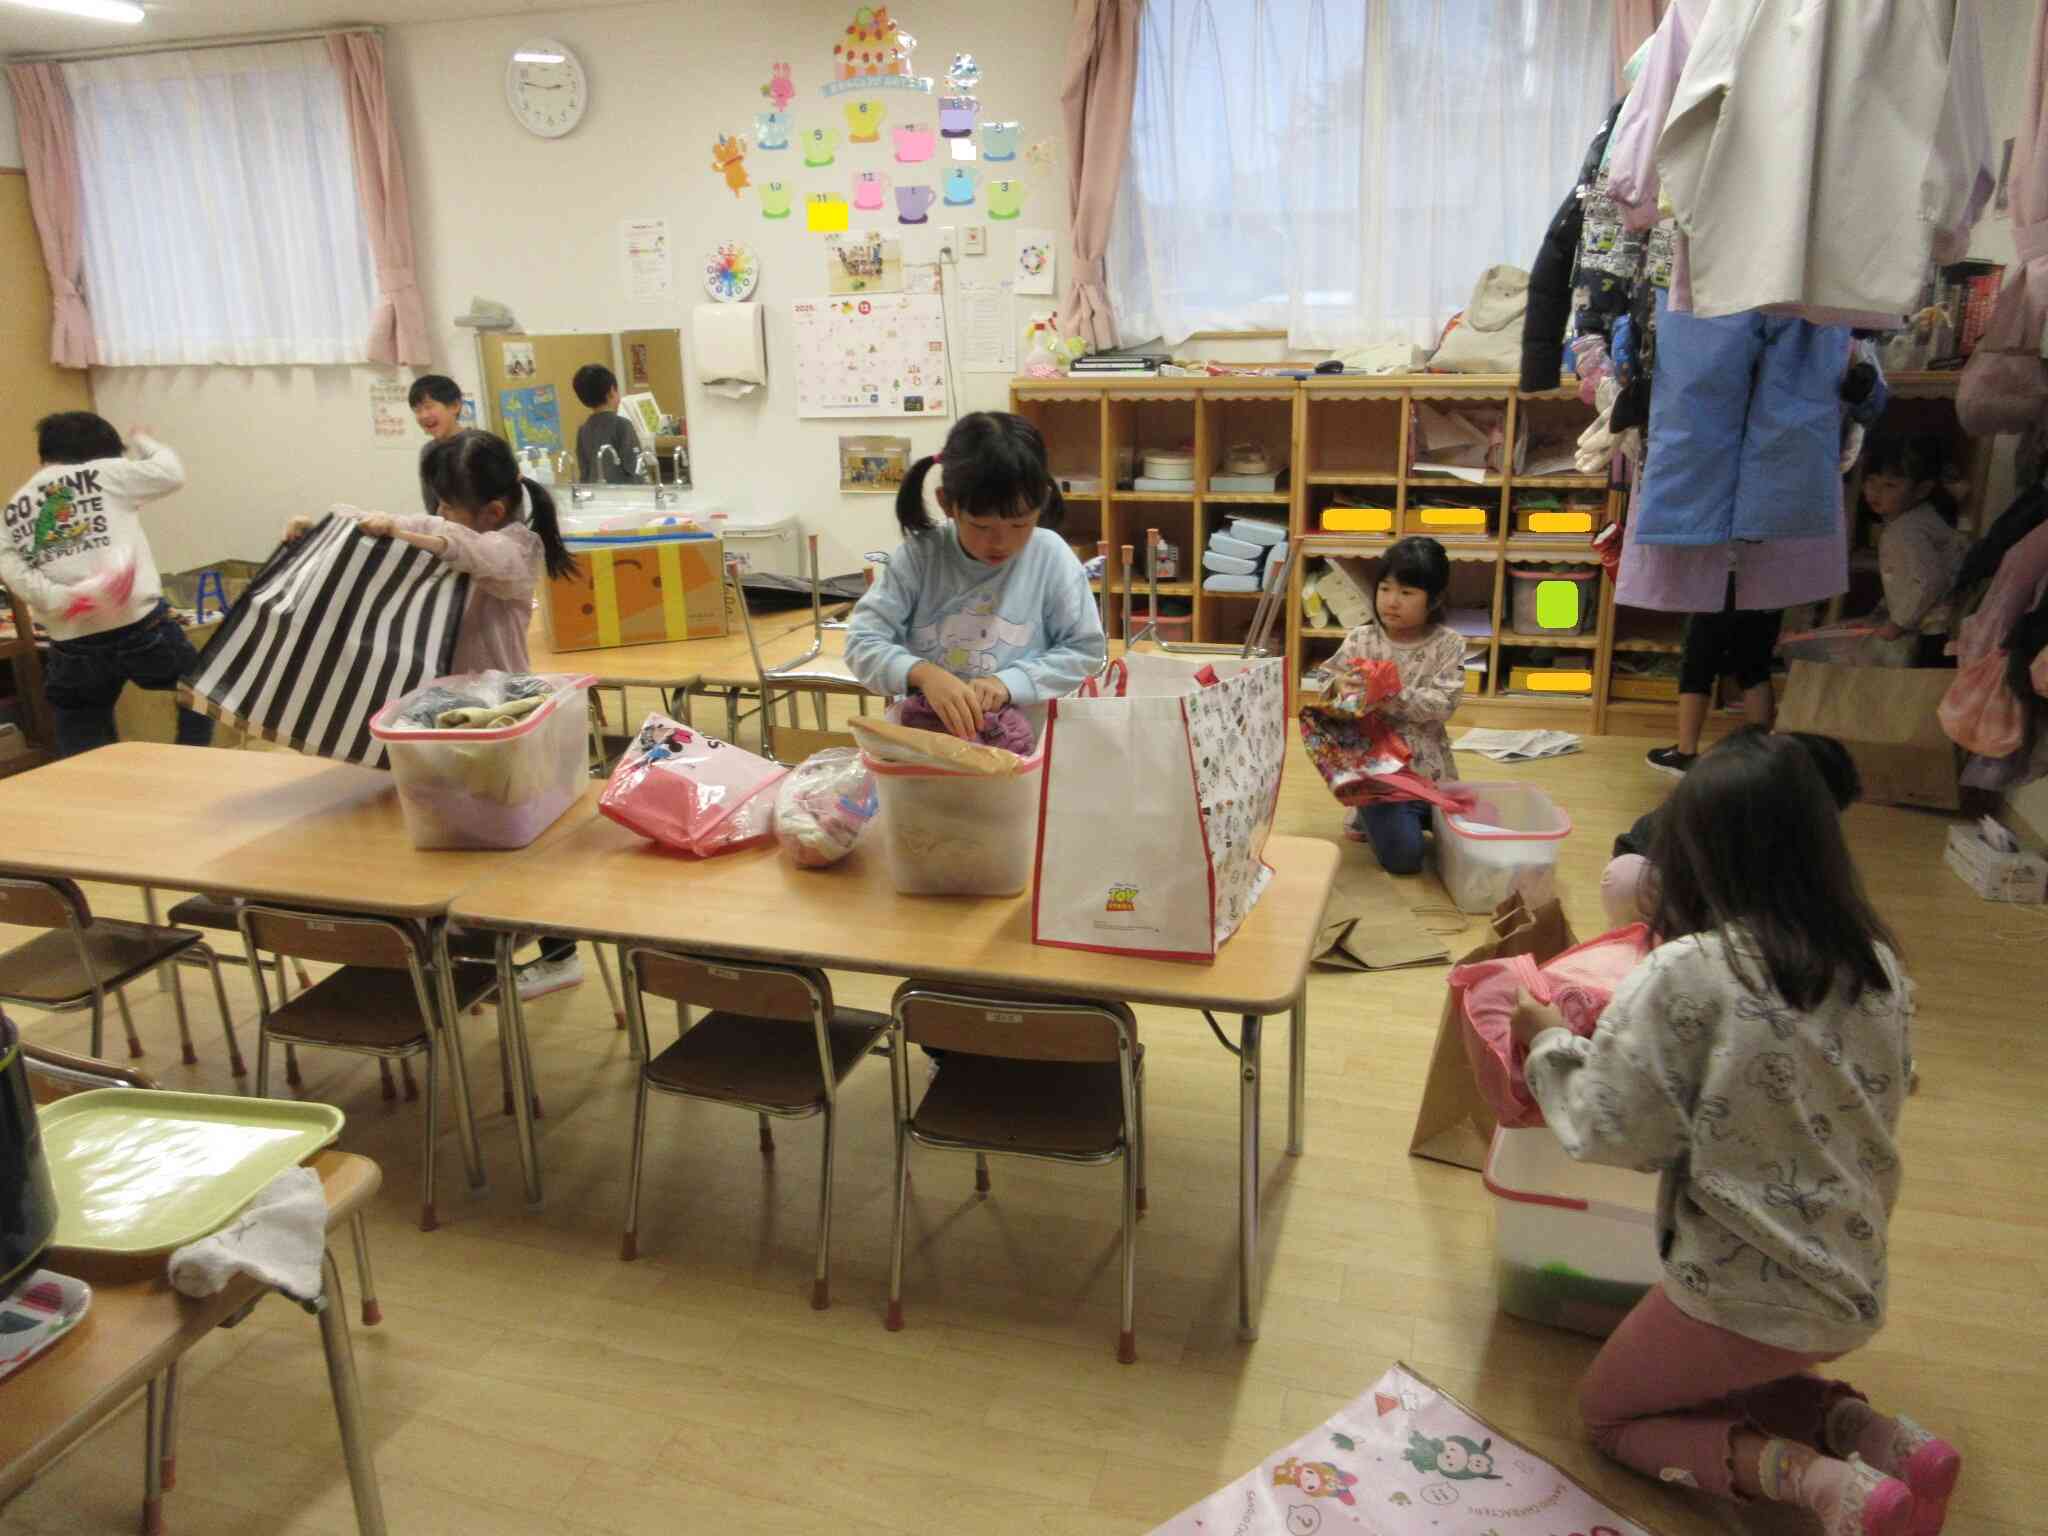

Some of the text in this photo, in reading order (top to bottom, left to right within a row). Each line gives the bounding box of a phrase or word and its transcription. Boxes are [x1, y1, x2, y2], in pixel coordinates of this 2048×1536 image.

[859, 103, 868, 113] 6
[813, 129, 823, 141] 5
[955, 168, 964, 178] 2
[1000, 182, 1009, 192] 3
